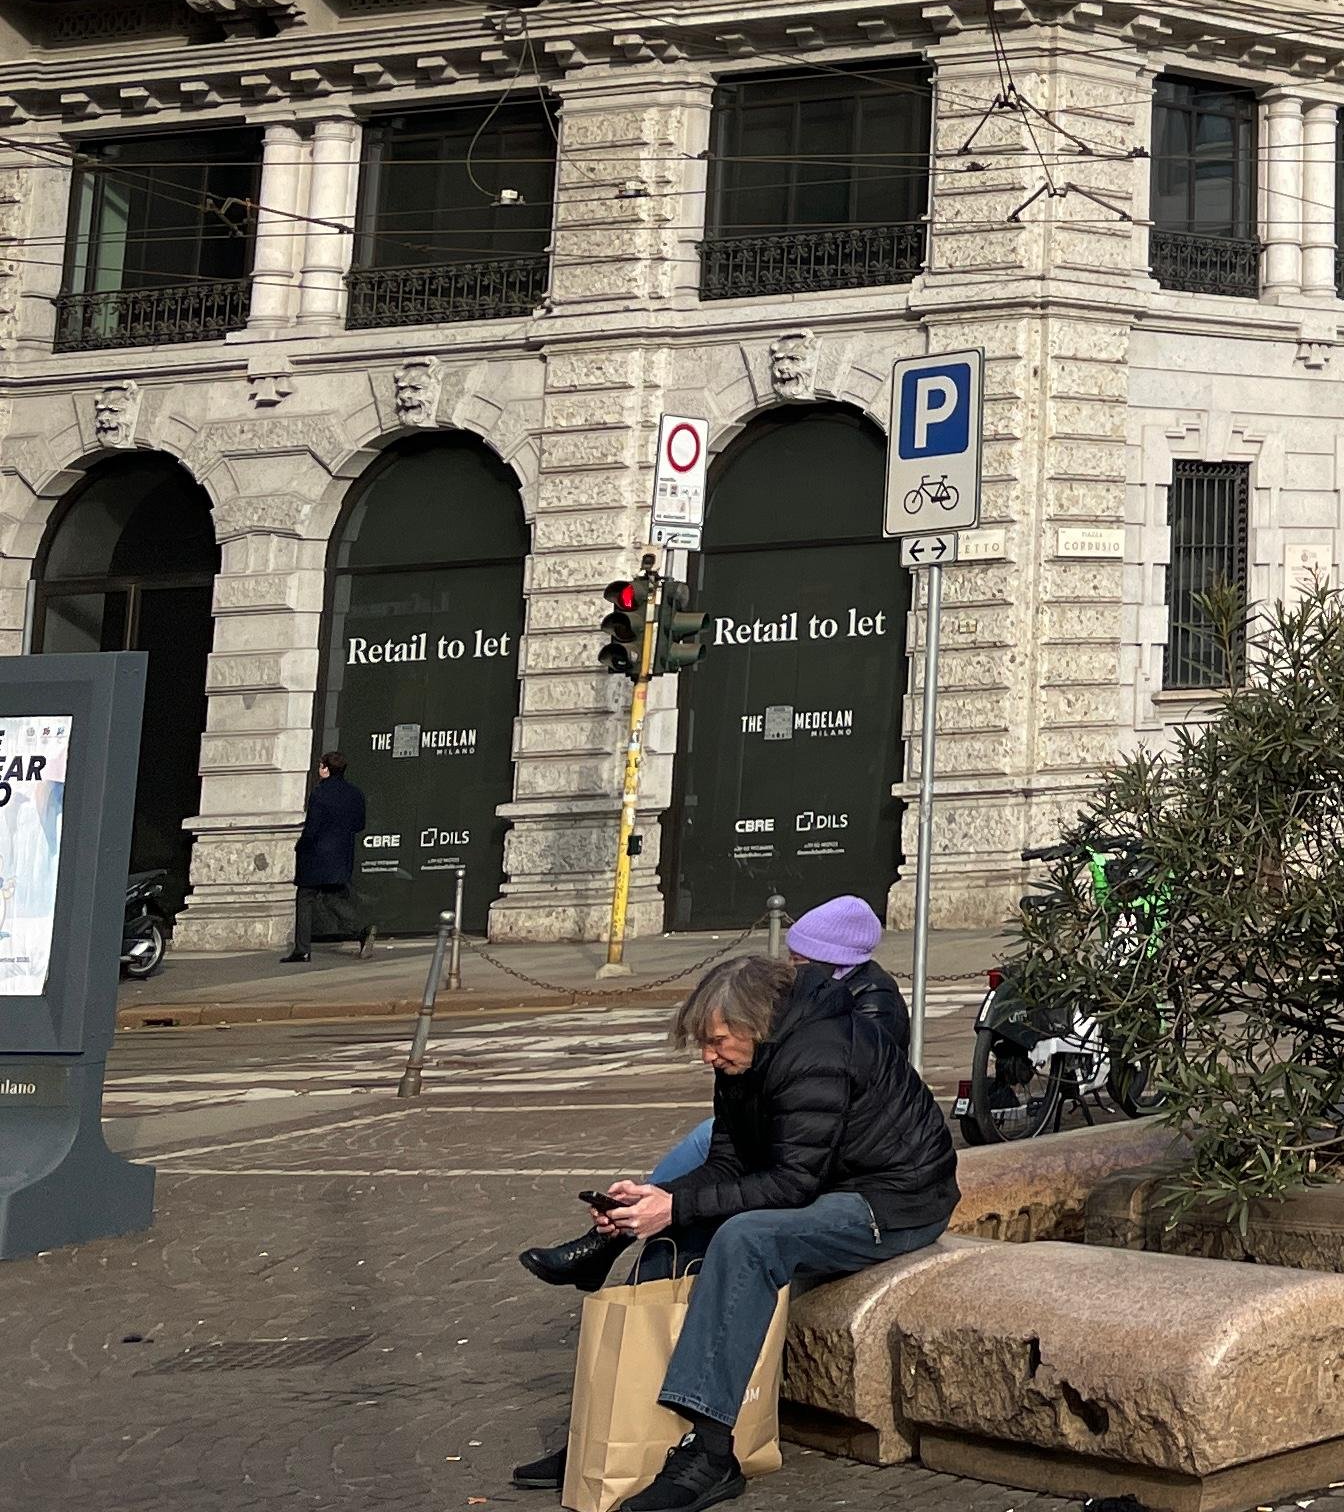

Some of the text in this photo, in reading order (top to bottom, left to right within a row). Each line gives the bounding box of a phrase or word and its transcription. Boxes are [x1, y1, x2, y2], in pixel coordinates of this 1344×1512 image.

[914, 375, 958, 448] P
[959, 542, 1000, 555] ETTO
[1064, 541, 1120, 552] CORDUSIO
[713, 607, 887, 646] Retail to let
[346, 629, 511, 665] Retail to let
[741, 710, 853, 733] THE MEDELAN
[371, 728, 477, 751] THE MEDELAN
[810, 729, 852, 737] MILANO
[436, 747, 476, 756] MILANO
[735, 818, 775, 833] CBRE
[816, 813, 849, 829] DILS
[363, 834, 401, 848] CBRE
[440, 830, 470, 845] DILS
